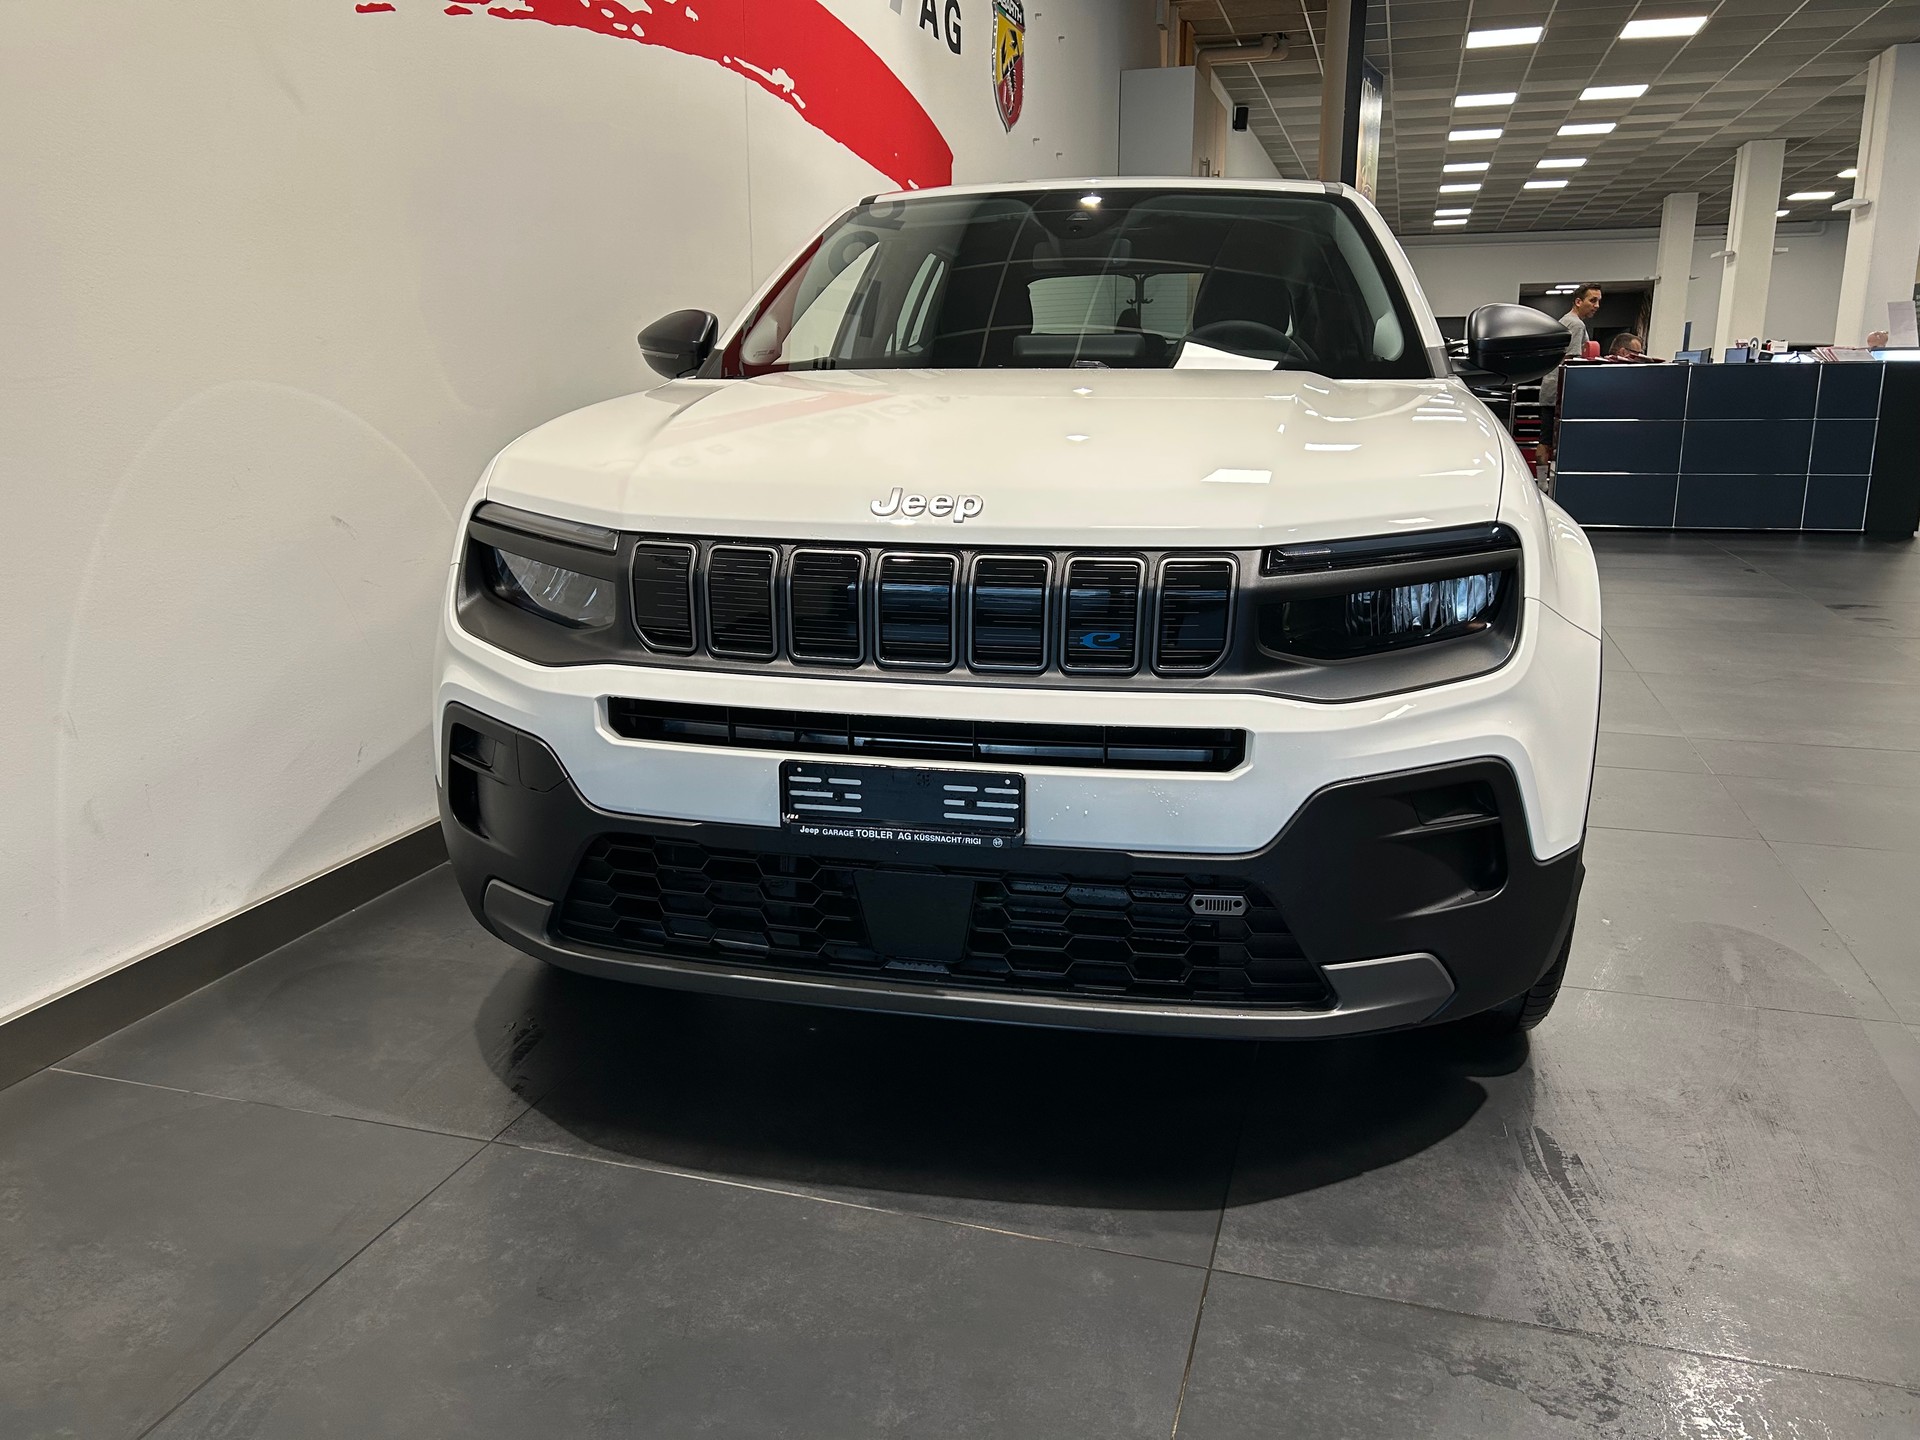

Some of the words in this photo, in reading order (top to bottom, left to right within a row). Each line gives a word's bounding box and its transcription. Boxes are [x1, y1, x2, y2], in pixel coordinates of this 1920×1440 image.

[919, 0, 962, 55] AG
[870, 487, 984, 523] Jeep
[800, 825, 819, 835] Jeep
[822, 828, 854, 837] GARAGE
[855, 829, 893, 839] TOBLER
[897, 832, 912, 841] AG
